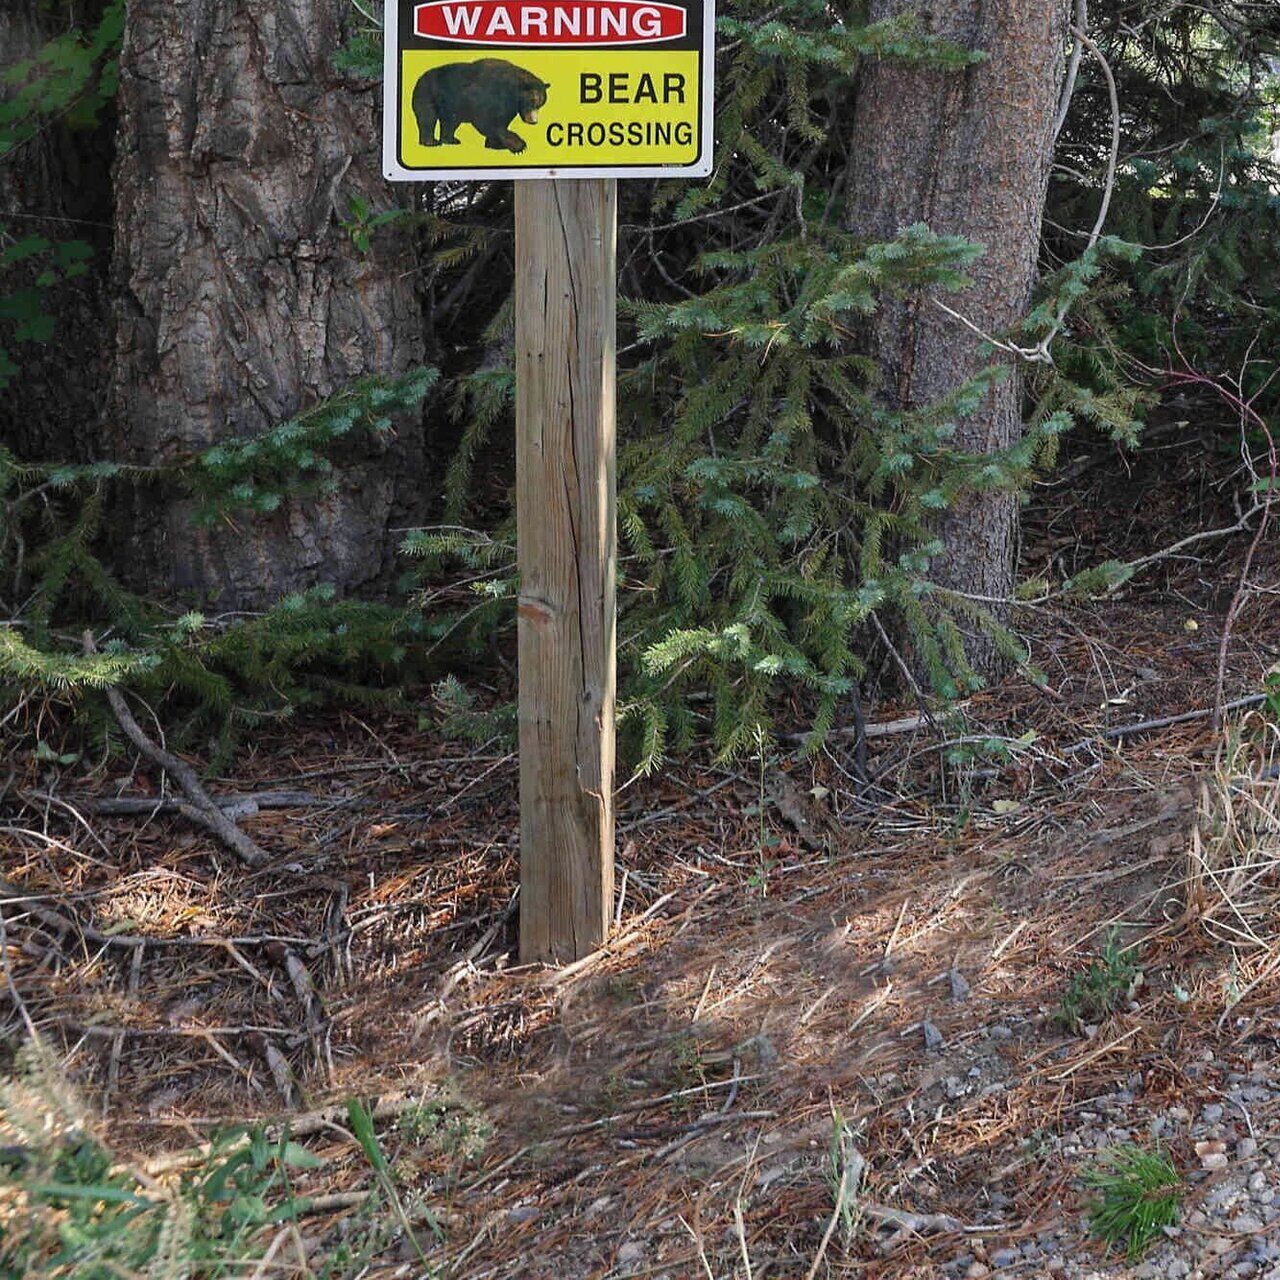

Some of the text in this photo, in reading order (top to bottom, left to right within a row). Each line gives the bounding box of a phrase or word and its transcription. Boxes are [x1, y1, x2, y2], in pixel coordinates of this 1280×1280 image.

[441, 6, 662, 37] WARNING
[579, 73, 687, 104] BEAR
[546, 122, 693, 147] CROSSING
